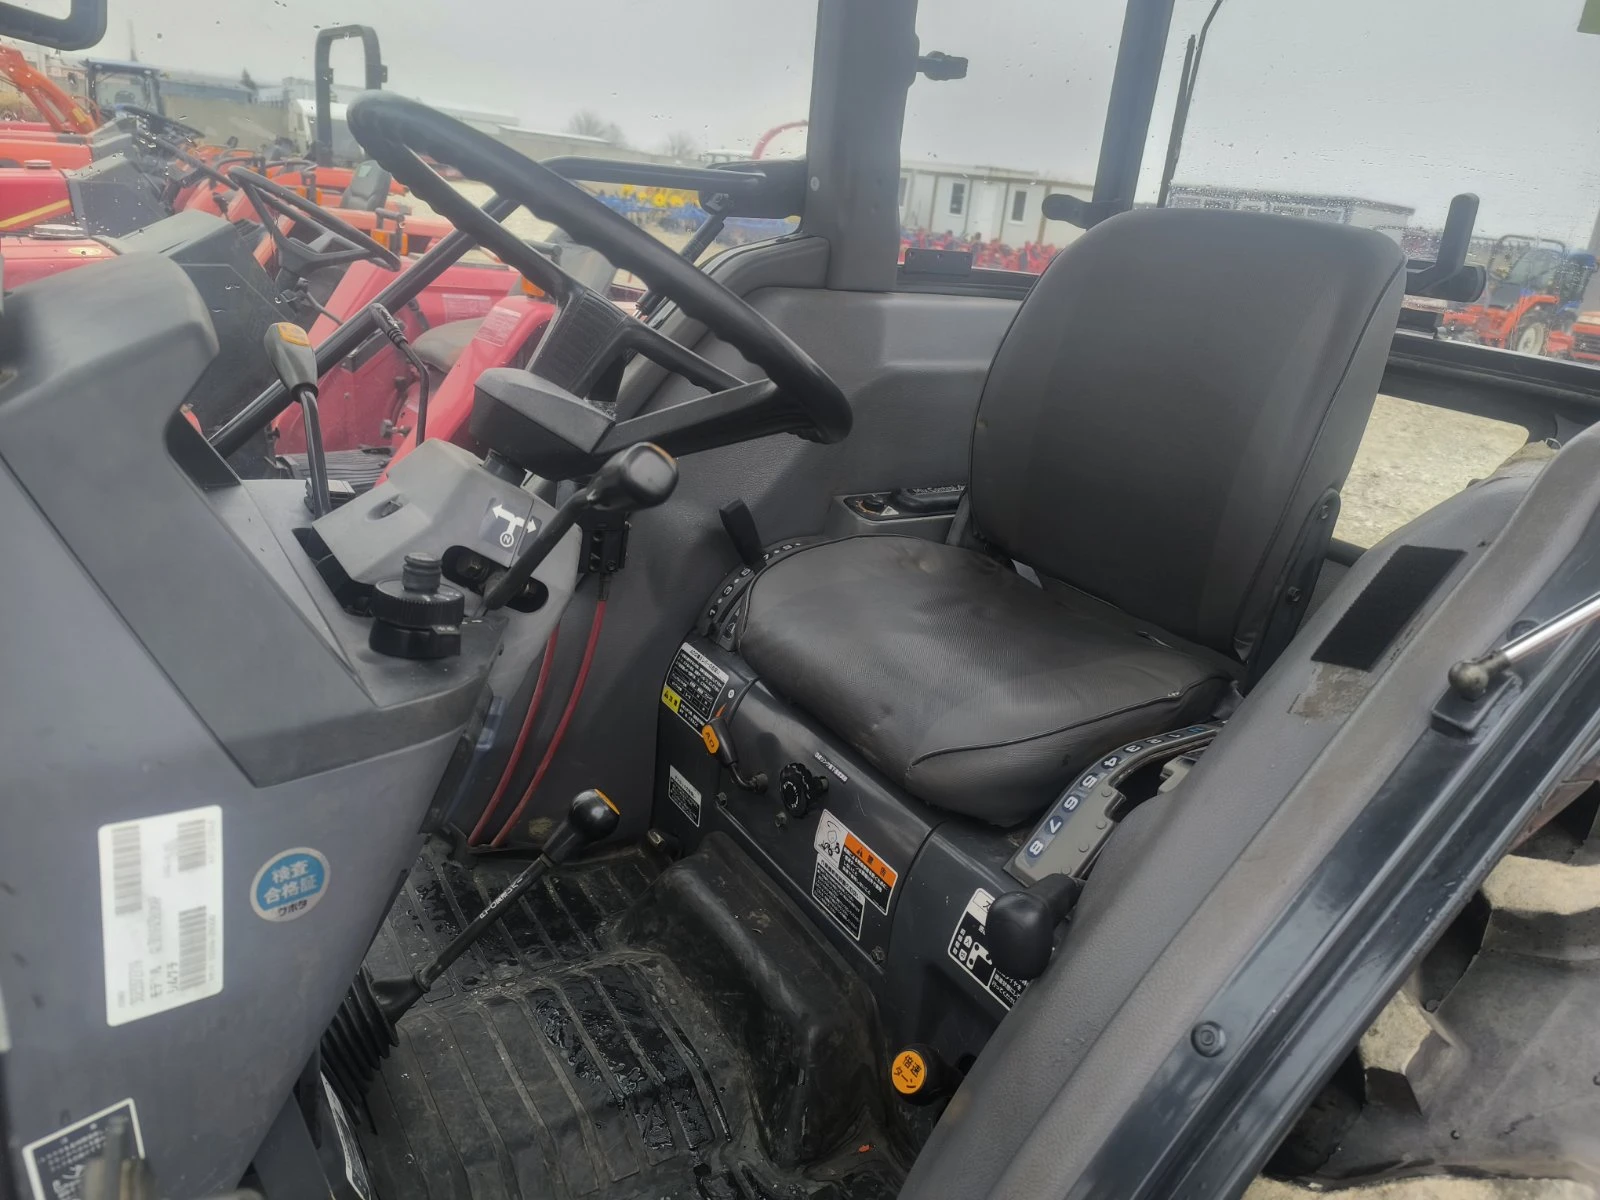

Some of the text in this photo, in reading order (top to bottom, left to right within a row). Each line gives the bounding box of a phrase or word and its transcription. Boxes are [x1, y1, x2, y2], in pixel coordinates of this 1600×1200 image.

[503, 534, 511, 544] N
[1125, 745, 1141, 753] 3
[1104, 756, 1117, 768] 4
[1081, 774, 1098, 789] 5
[1063, 795, 1079, 811] 6
[1049, 818, 1062, 835] 7
[1028, 839, 1044, 856] 8
[272, 860, 309, 884] 検査
[264, 873, 317, 905] 合格証
[278, 899, 308, 917] クボタ
[903, 1054, 922, 1078] 倍速
[893, 1066, 917, 1089] ターン
